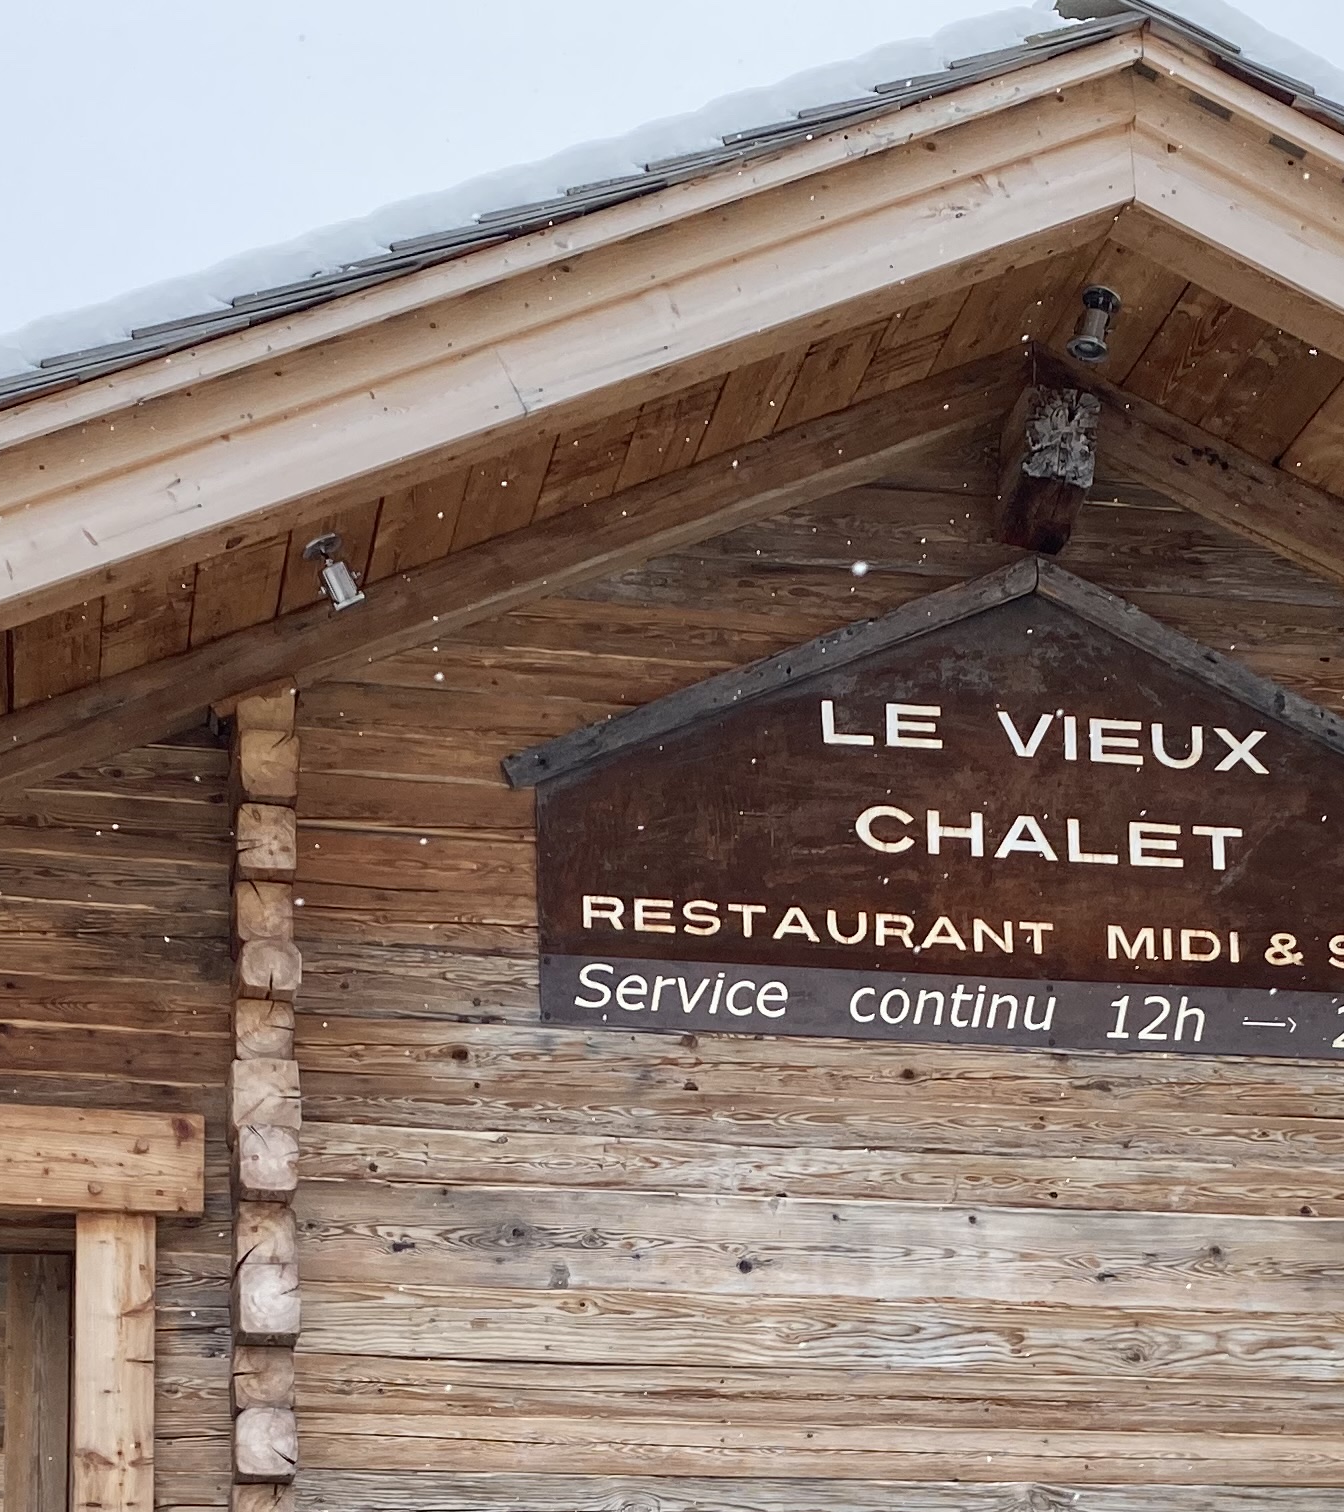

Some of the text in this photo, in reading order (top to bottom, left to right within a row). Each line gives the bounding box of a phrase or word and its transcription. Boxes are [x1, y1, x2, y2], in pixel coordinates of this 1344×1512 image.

[820, 699, 1271, 776] LE VIEUX
[854, 804, 1244, 873] CHALET
[581, 894, 1055, 957] RESTAURANT
[1106, 923, 1241, 964] MIDI
[1263, 931, 1305, 967] &
[573, 962, 790, 1019] Service
[848, 983, 1058, 1032] continu
[1105, 994, 1207, 1043] 12h
